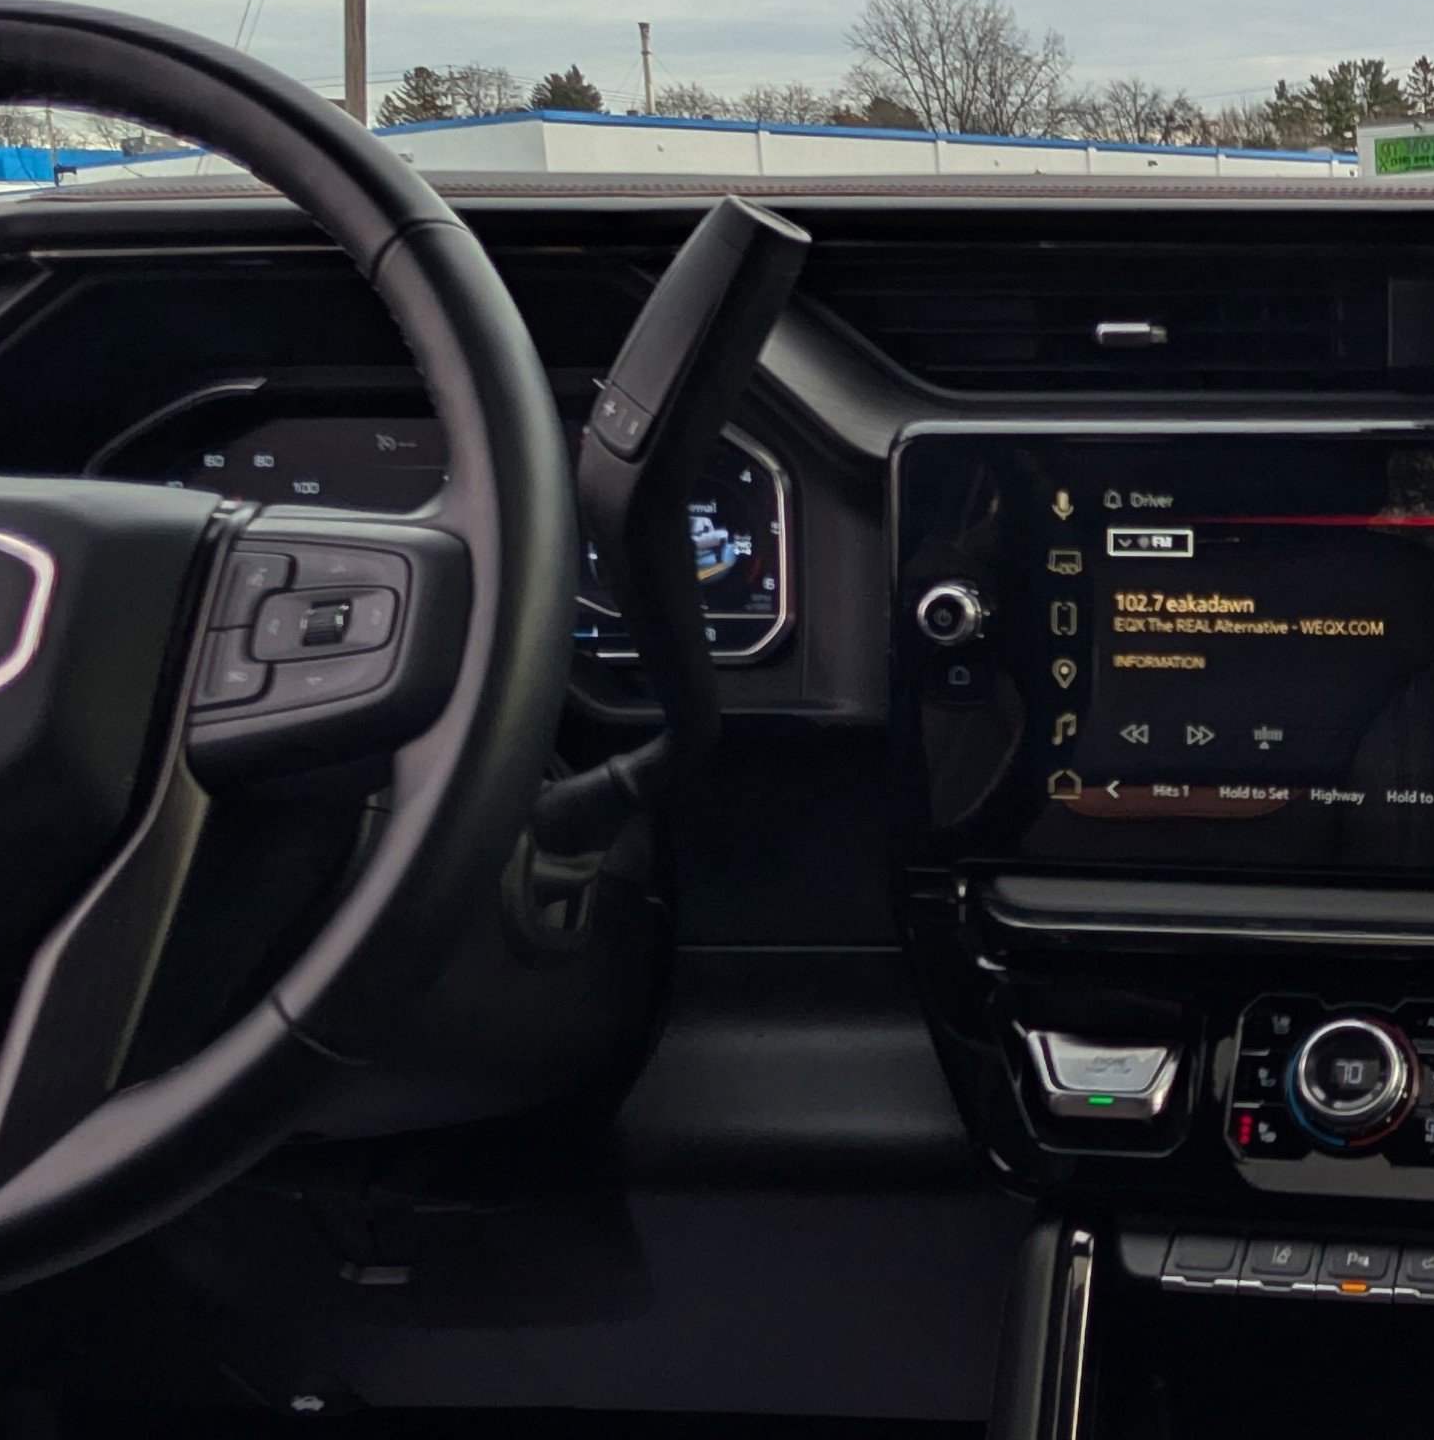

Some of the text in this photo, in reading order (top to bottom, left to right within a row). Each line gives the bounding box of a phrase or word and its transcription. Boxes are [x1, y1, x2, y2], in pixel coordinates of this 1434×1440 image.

[1130, 491, 1174, 509] Driver
[1115, 591, 1255, 613] 102.7 eakadawn
[1114, 617, 1145, 632] EQX
[1147, 617, 1173, 633] The
[1176, 619, 1211, 634] REAL
[1215, 619, 1289, 635] Alternative
[1300, 618, 1385, 636] WEQX.COM
[1113, 655, 1206, 669] INFORMATION
[1220, 786, 1289, 801] Hold to Set
[1311, 789, 1364, 806] Highway
[1387, 790, 1415, 804] Hold
[1419, 792, 1434, 804] to
[1338, 1061, 1364, 1085] 70
